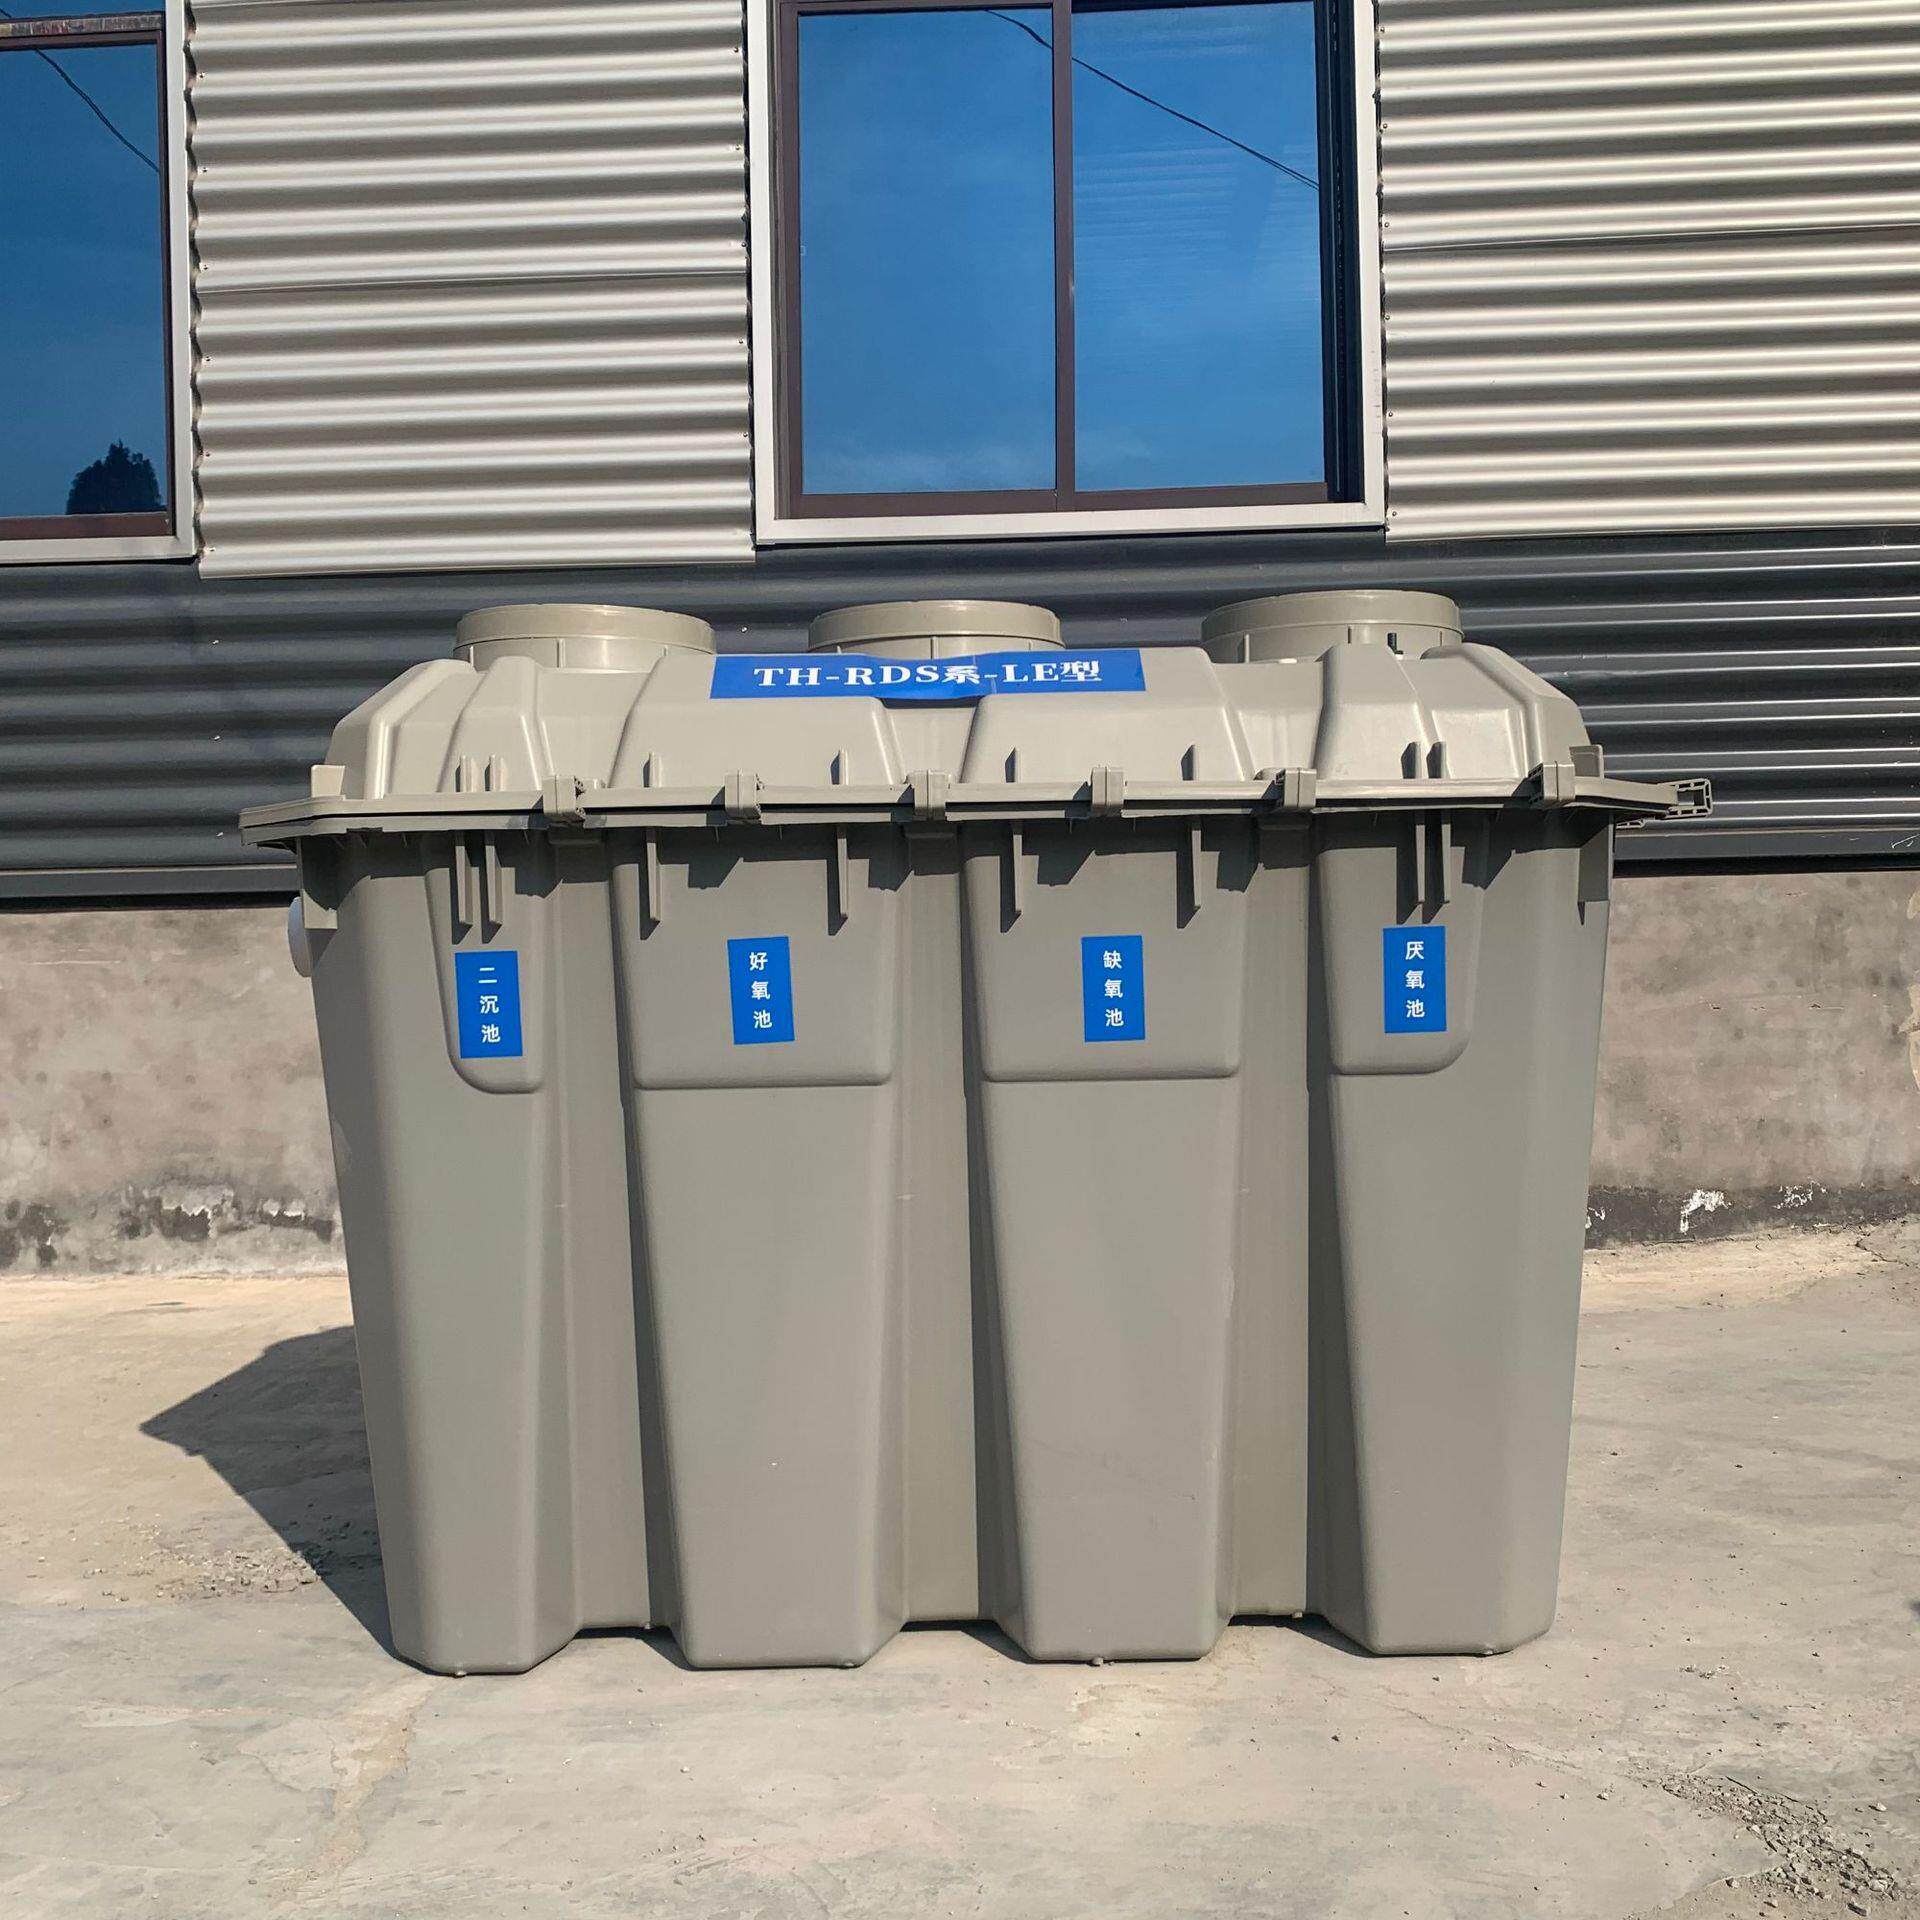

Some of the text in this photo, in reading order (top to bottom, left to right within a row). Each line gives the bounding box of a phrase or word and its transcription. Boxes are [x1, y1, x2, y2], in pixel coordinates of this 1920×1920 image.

[478, 967, 501, 1043] 二沉池
[749, 952, 773, 1029] 好氧池
[1103, 950, 1125, 1027] 缺氧池
[1405, 941, 1425, 1018] 厌氧池
